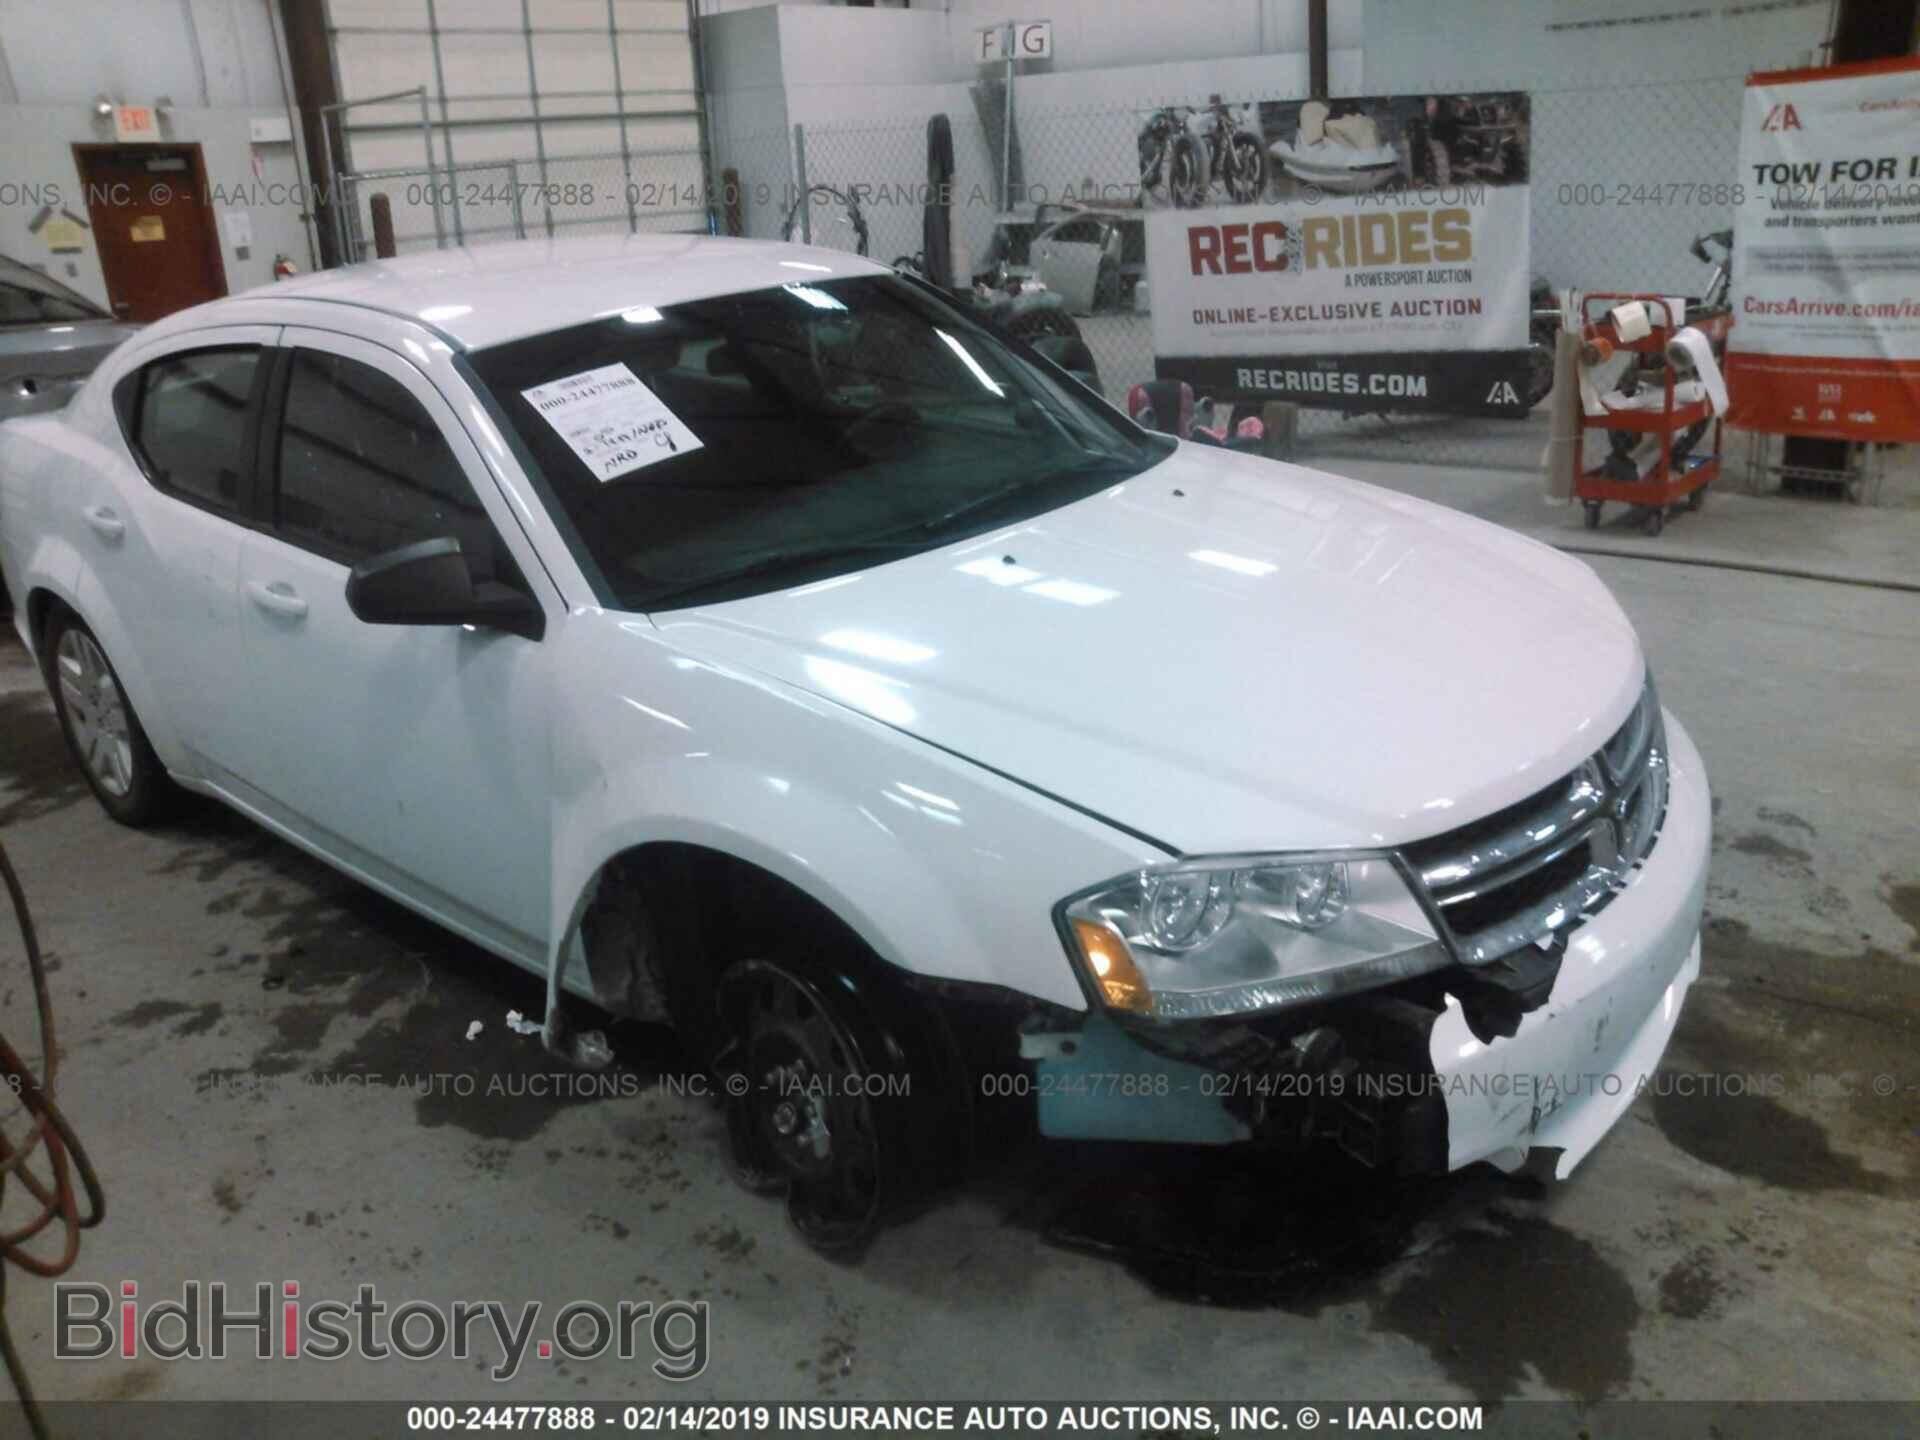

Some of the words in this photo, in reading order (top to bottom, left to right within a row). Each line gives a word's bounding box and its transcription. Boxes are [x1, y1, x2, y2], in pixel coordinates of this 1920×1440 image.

[981, 32, 995, 57] F
[1021, 25, 1044, 53] G
[1753, 162, 1821, 185] TOW
[1830, 157, 1897, 183] FOR
[1764, 214, 1790, 228] and
[1186, 220, 1289, 276] REC
[1301, 208, 1472, 270] RIDES
[1354, 271, 1425, 288] POWERSPORT
[1426, 268, 1472, 285] AUCTION
[1192, 301, 1383, 326] ONLINE-EXCLUSIVE
[1389, 298, 1483, 318] AUCTION
[1237, 367, 1428, 397] RECRIDES.COM
